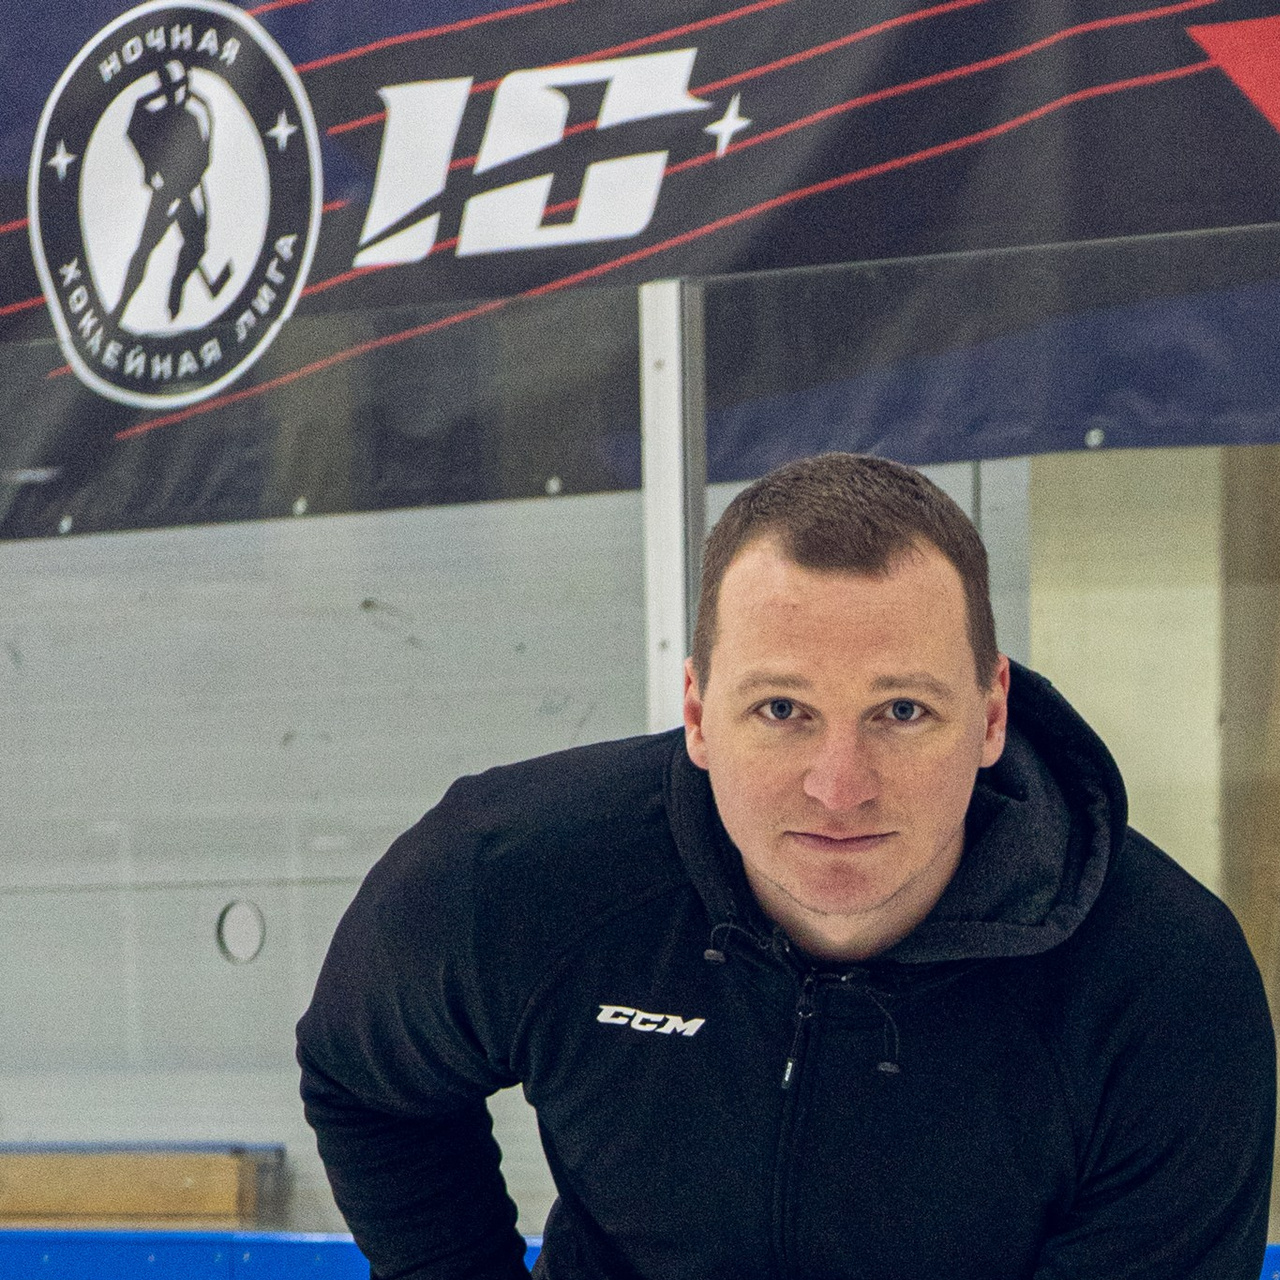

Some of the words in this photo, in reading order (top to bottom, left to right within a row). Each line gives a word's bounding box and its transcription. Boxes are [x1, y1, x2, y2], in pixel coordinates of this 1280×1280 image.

[100, 24, 242, 82] НОЧНАЯ
[234, 232, 299, 341] ЛИГА
[597, 1005, 706, 1036] CCM
